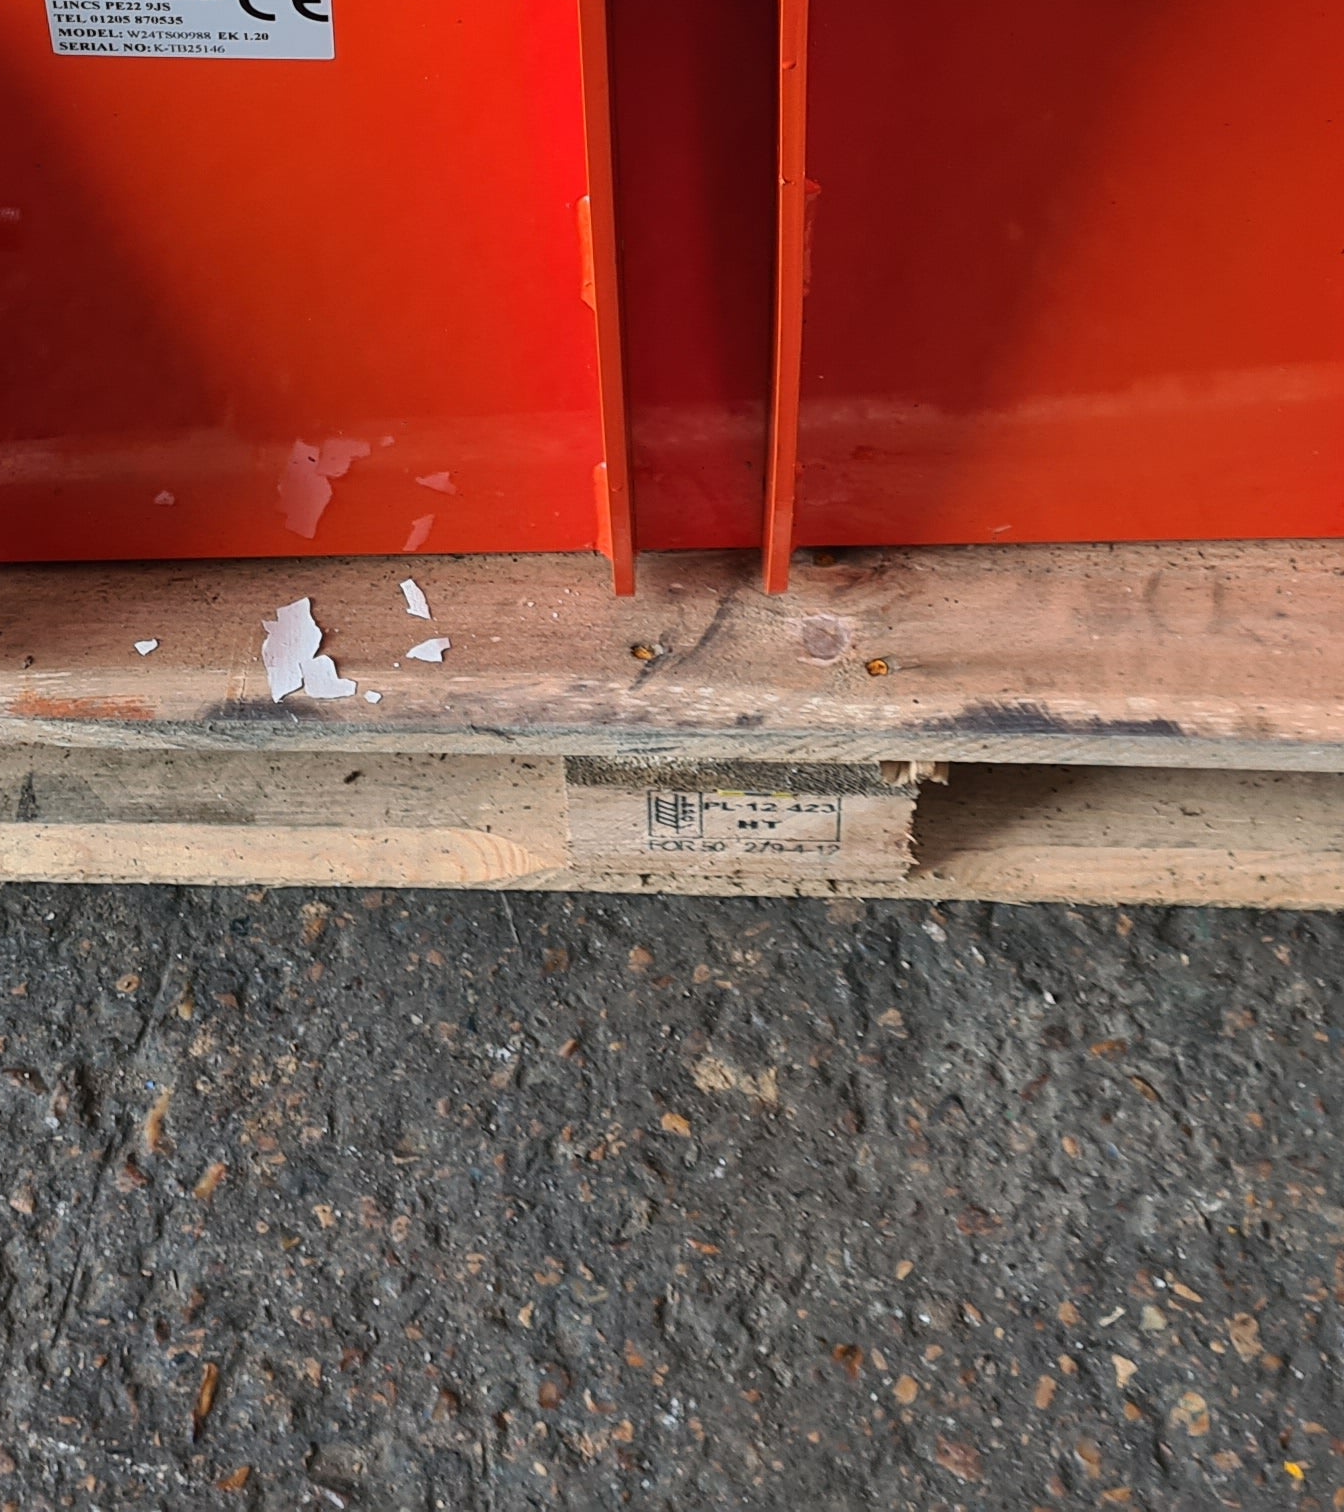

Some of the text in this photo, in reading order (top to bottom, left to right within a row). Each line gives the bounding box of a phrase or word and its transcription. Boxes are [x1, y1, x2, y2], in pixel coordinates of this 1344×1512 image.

[52, 0, 171, 12] LINCS PE22 9JS
[53, 14, 184, 25] TEL 01205 870535
[58, 28, 124, 39] MODEL:
[218, 31, 240, 41] EK
[243, 32, 270, 41] 1.20
[58, 41, 119, 52] SERIAL
[122, 43, 151, 53] NO:
[737, 820, 783, 829] HT
